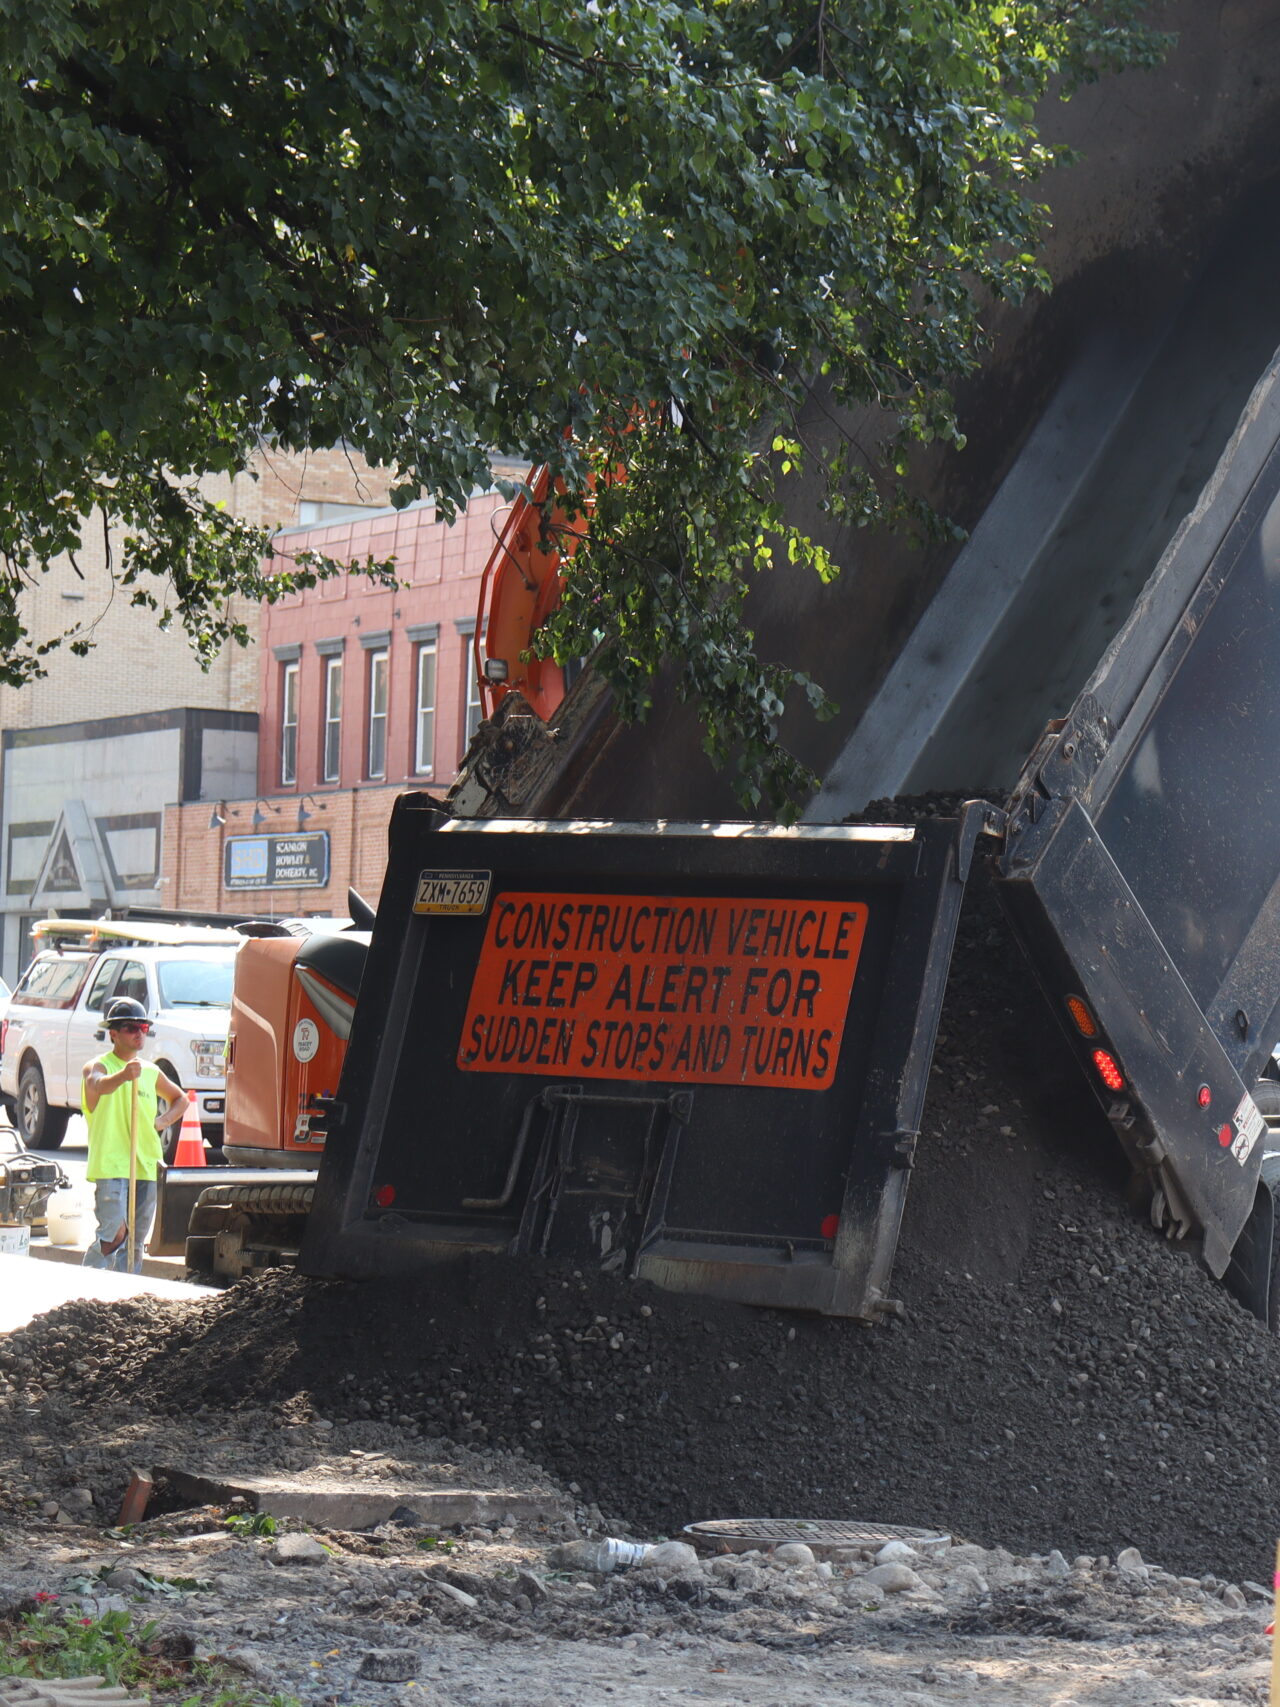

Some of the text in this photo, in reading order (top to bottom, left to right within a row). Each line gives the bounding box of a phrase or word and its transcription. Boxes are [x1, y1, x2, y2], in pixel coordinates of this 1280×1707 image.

[276, 842, 307, 854] SCANLON
[494, 902, 857, 960] CONSTRUCTION VEHICLE
[498, 959, 821, 1018] KEEP ALERT FOR
[467, 1014, 834, 1080] SUDDEN STOPS AND TURNS
